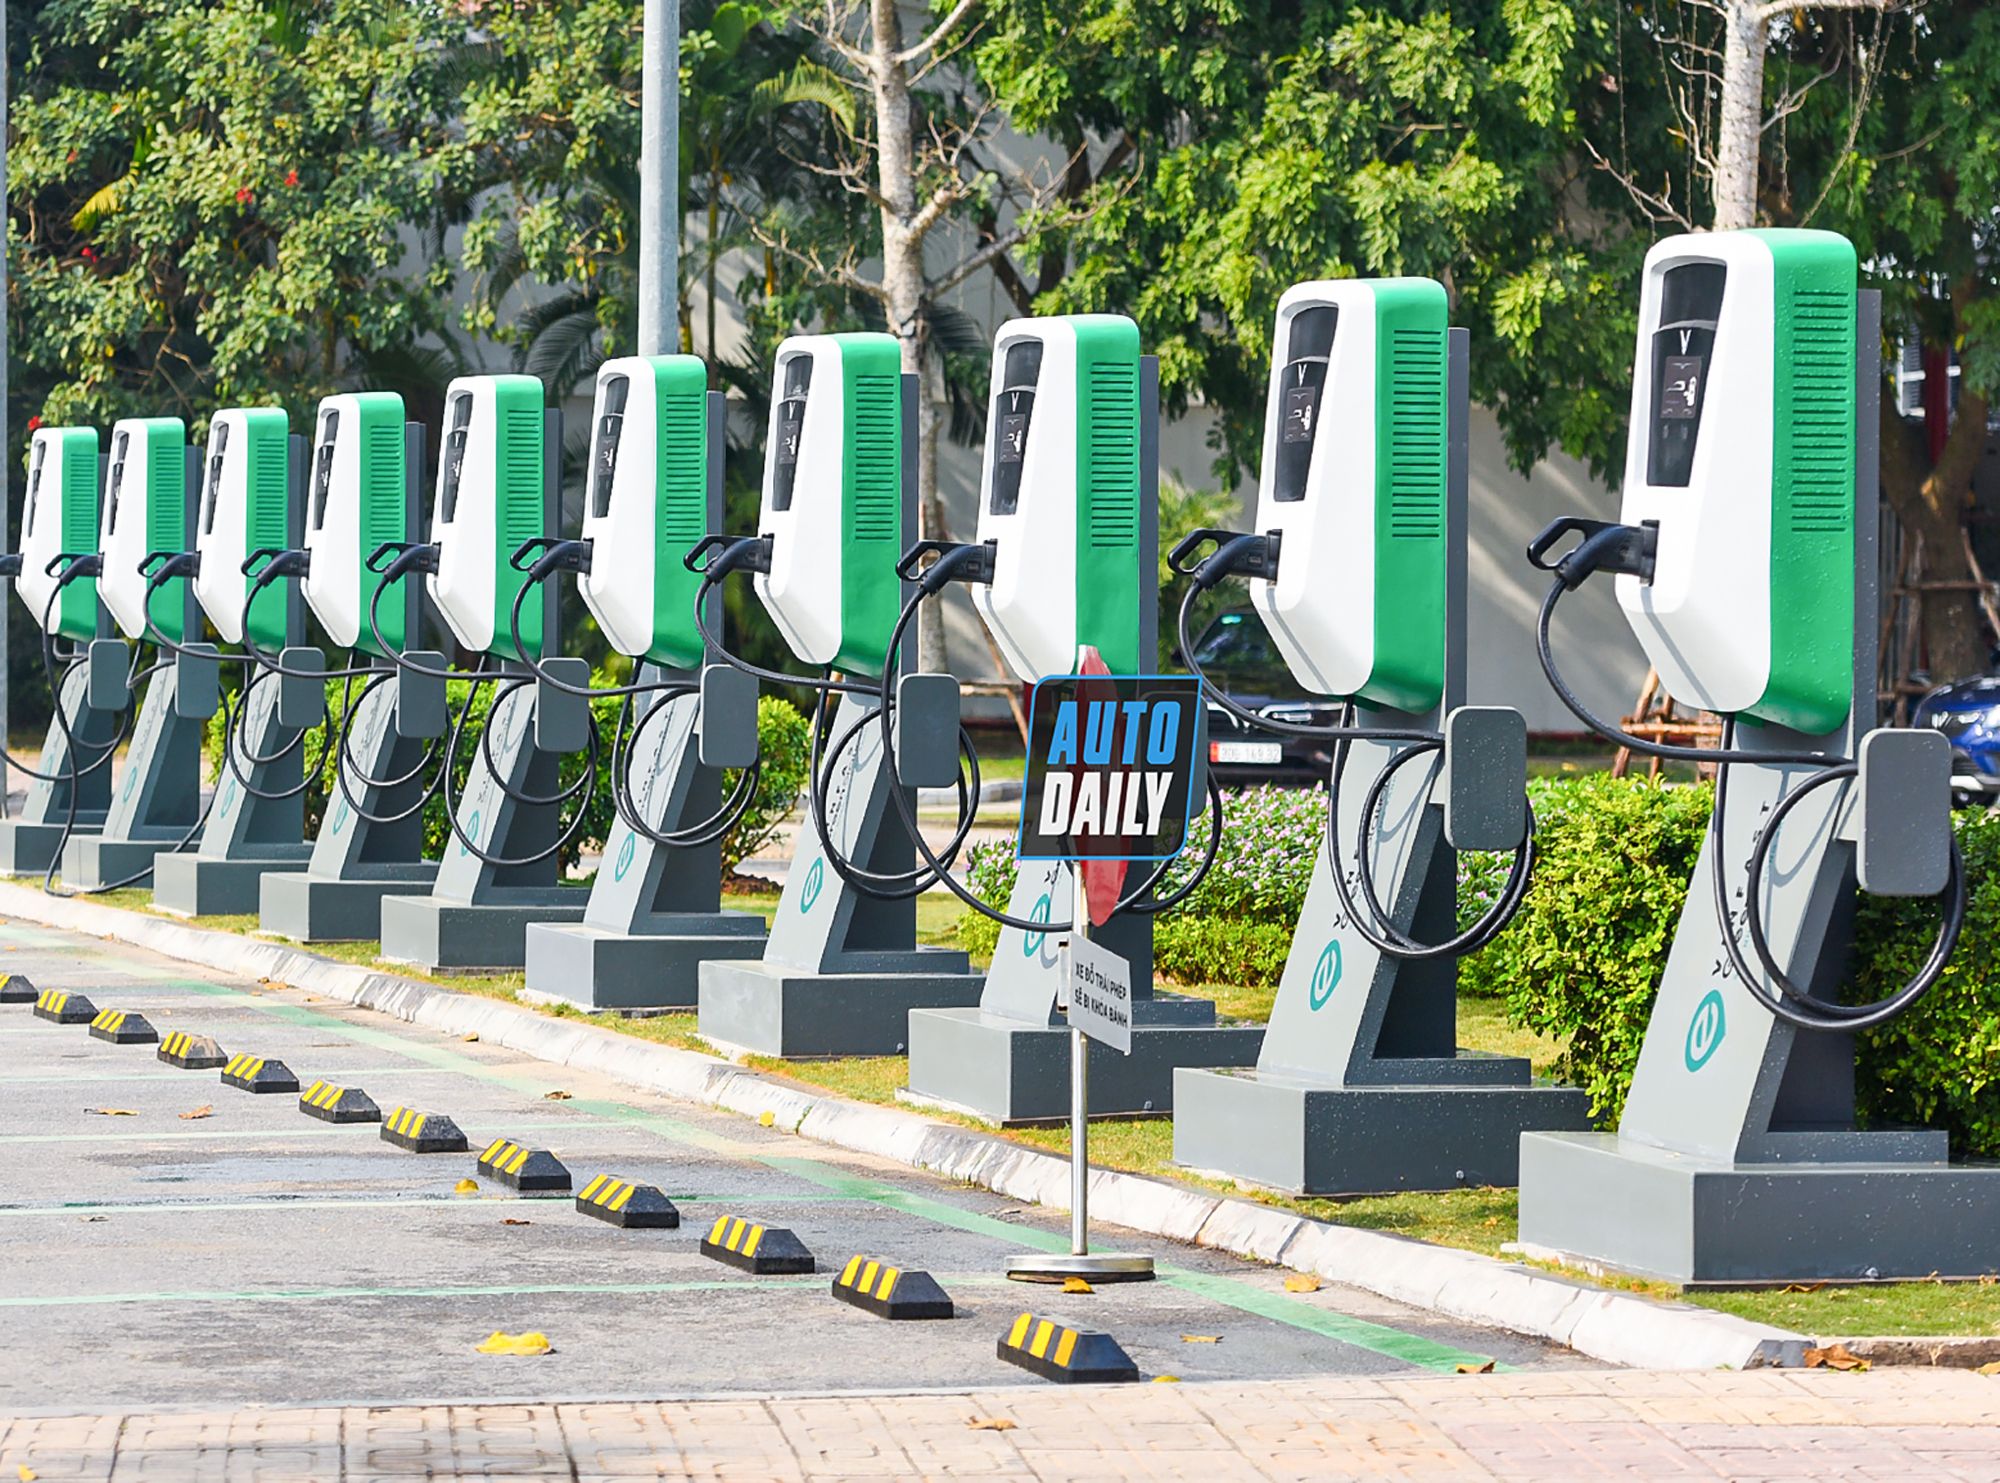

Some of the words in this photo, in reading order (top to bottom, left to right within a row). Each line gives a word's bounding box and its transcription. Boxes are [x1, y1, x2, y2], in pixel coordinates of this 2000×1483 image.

[1075, 962, 1084, 980] XE
[1095, 972, 1110, 993] TRÁI
[1110, 980, 1127, 1000] PHÉP
[1109, 1005, 1128, 1028] BÁNH
